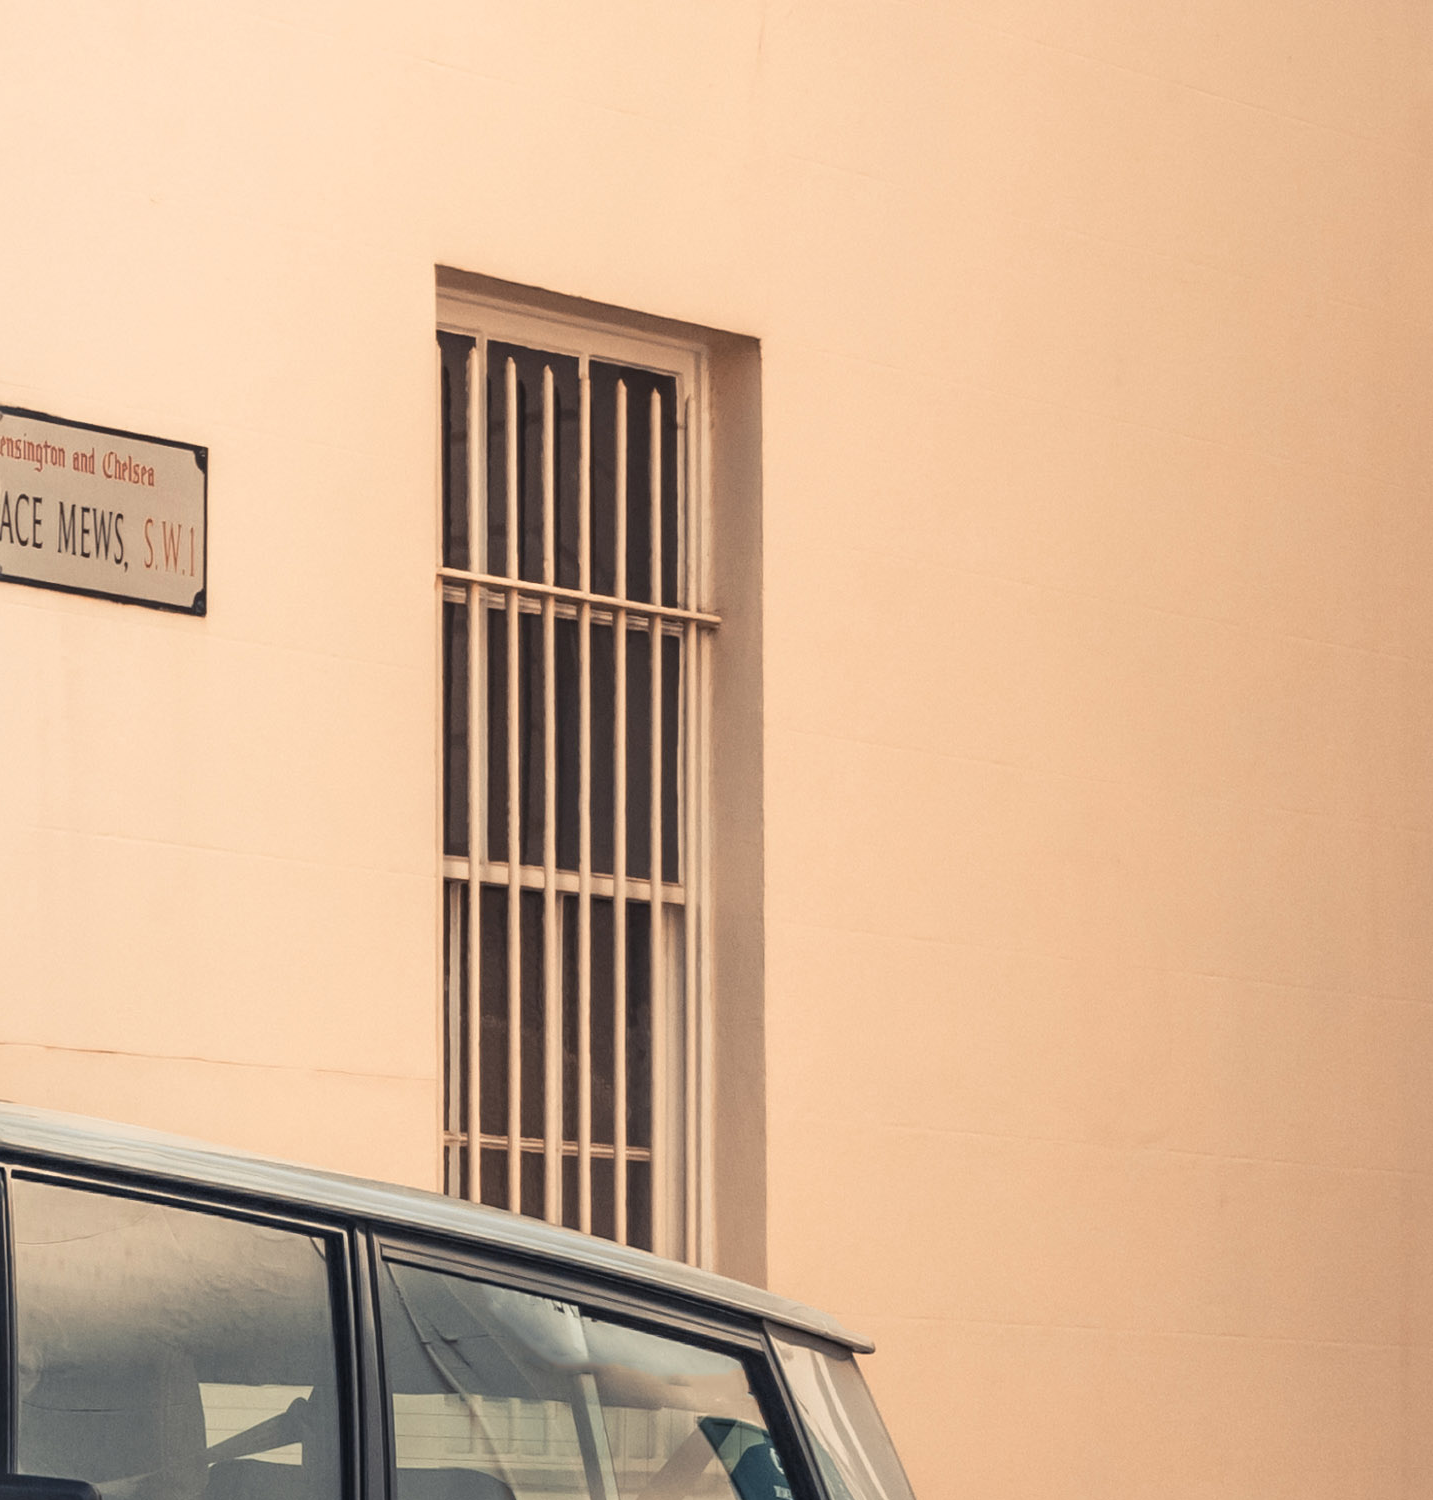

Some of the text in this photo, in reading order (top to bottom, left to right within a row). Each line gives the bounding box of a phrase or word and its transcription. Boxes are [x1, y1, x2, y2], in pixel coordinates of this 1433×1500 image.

[72, 449, 96, 475] and
[102, 451, 155, 487] Chelsea
[57, 501, 129, 573] MEWS,
